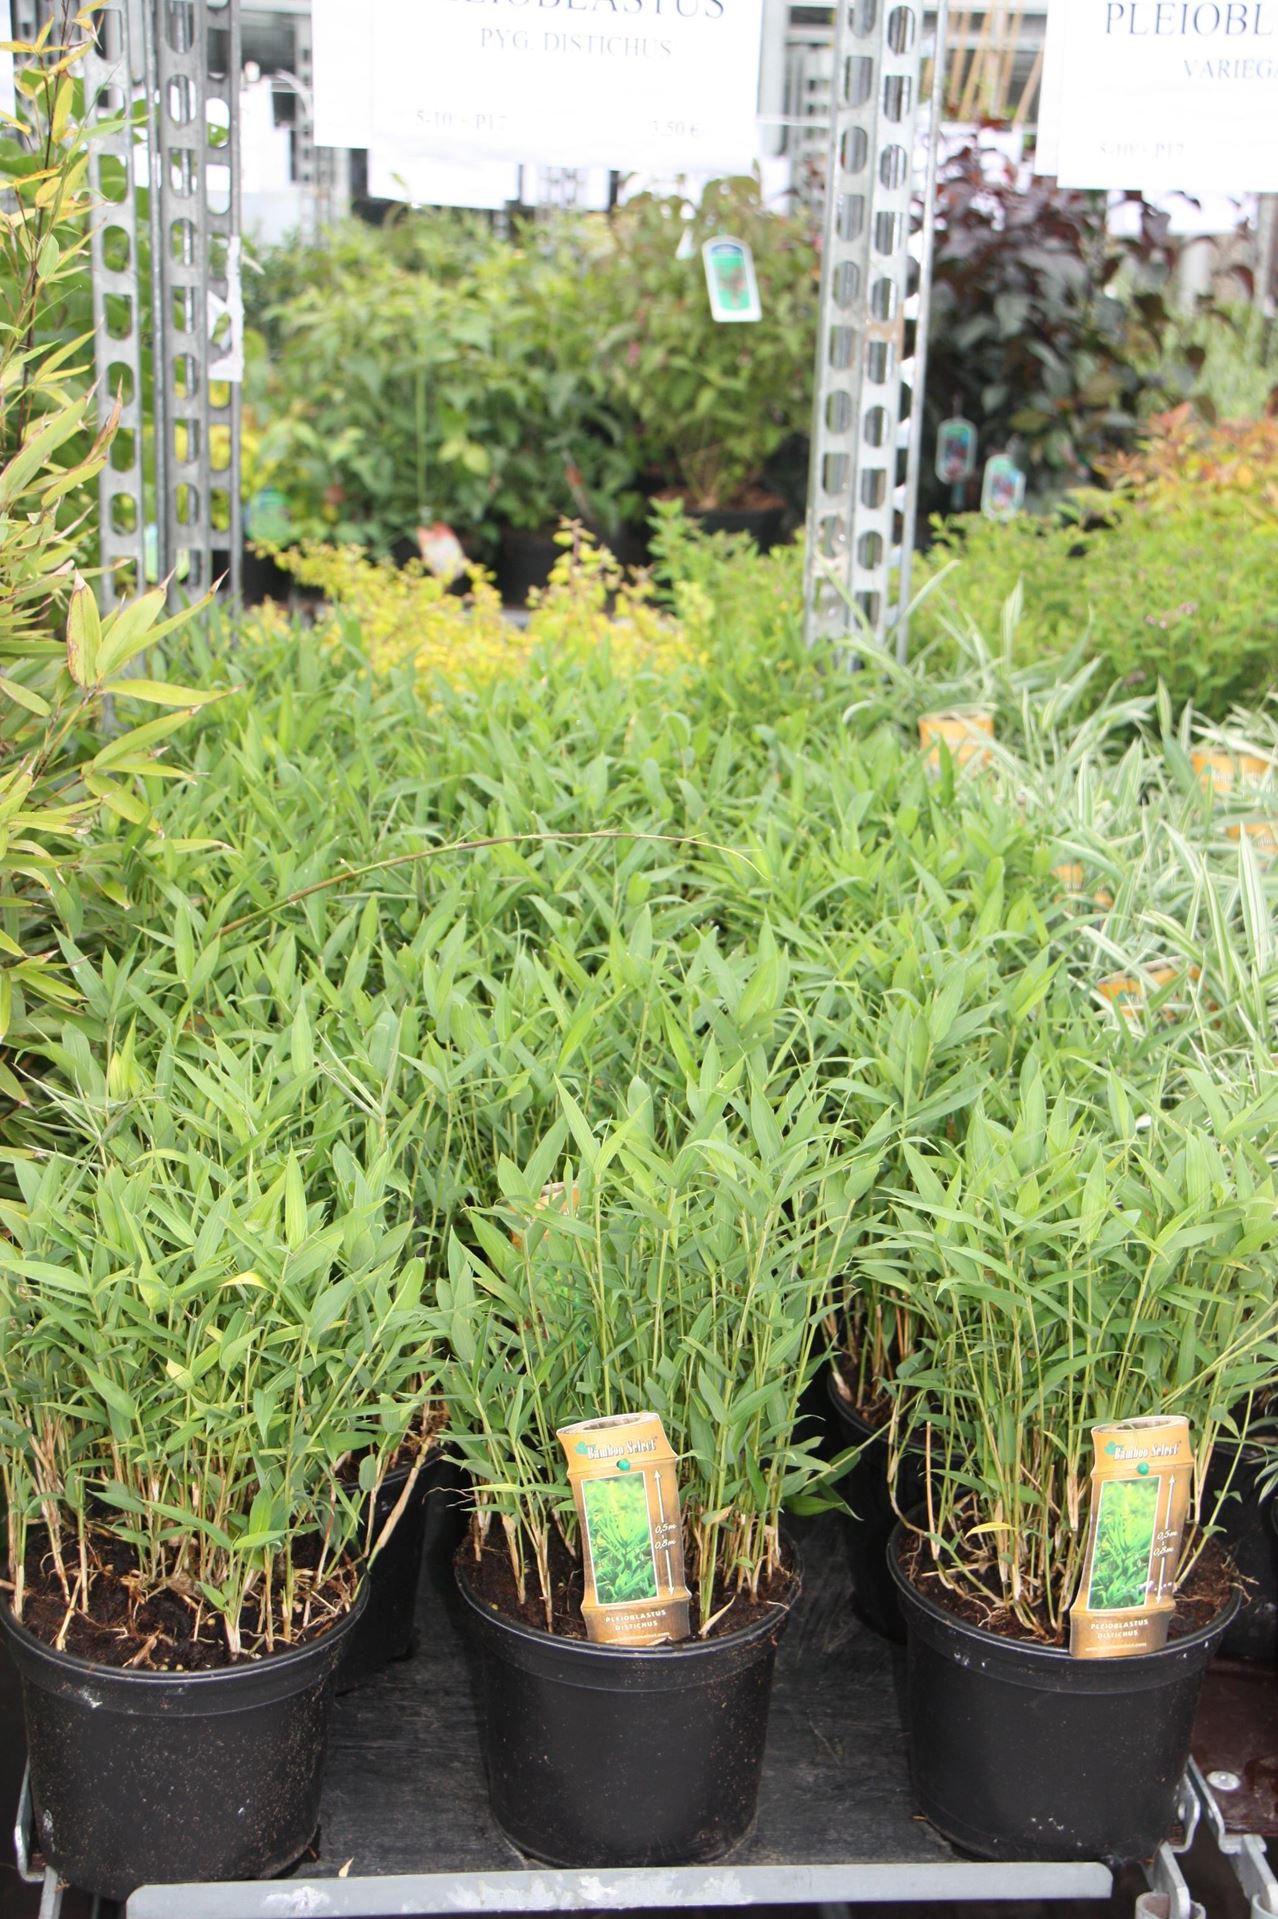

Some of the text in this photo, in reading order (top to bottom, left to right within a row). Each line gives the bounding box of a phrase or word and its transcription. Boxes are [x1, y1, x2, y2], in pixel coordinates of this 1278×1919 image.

[1105, 2, 1276, 36] PLEIOBL
[543, 31, 674, 58] DISTICHUS
[1183, 57, 1278, 80] VARIEG
[587, 1438, 657, 1460] Bamboo Select
[1114, 1442, 1178, 1460] Bamboo Select
[605, 1609, 666, 1622] PLEIOBLASTUS
[1090, 1618, 1149, 1630] PLEIOBLASTUS
[615, 1620, 658, 1631] DISTICHUS
[1097, 1629, 1139, 1640] DISTICHUS
